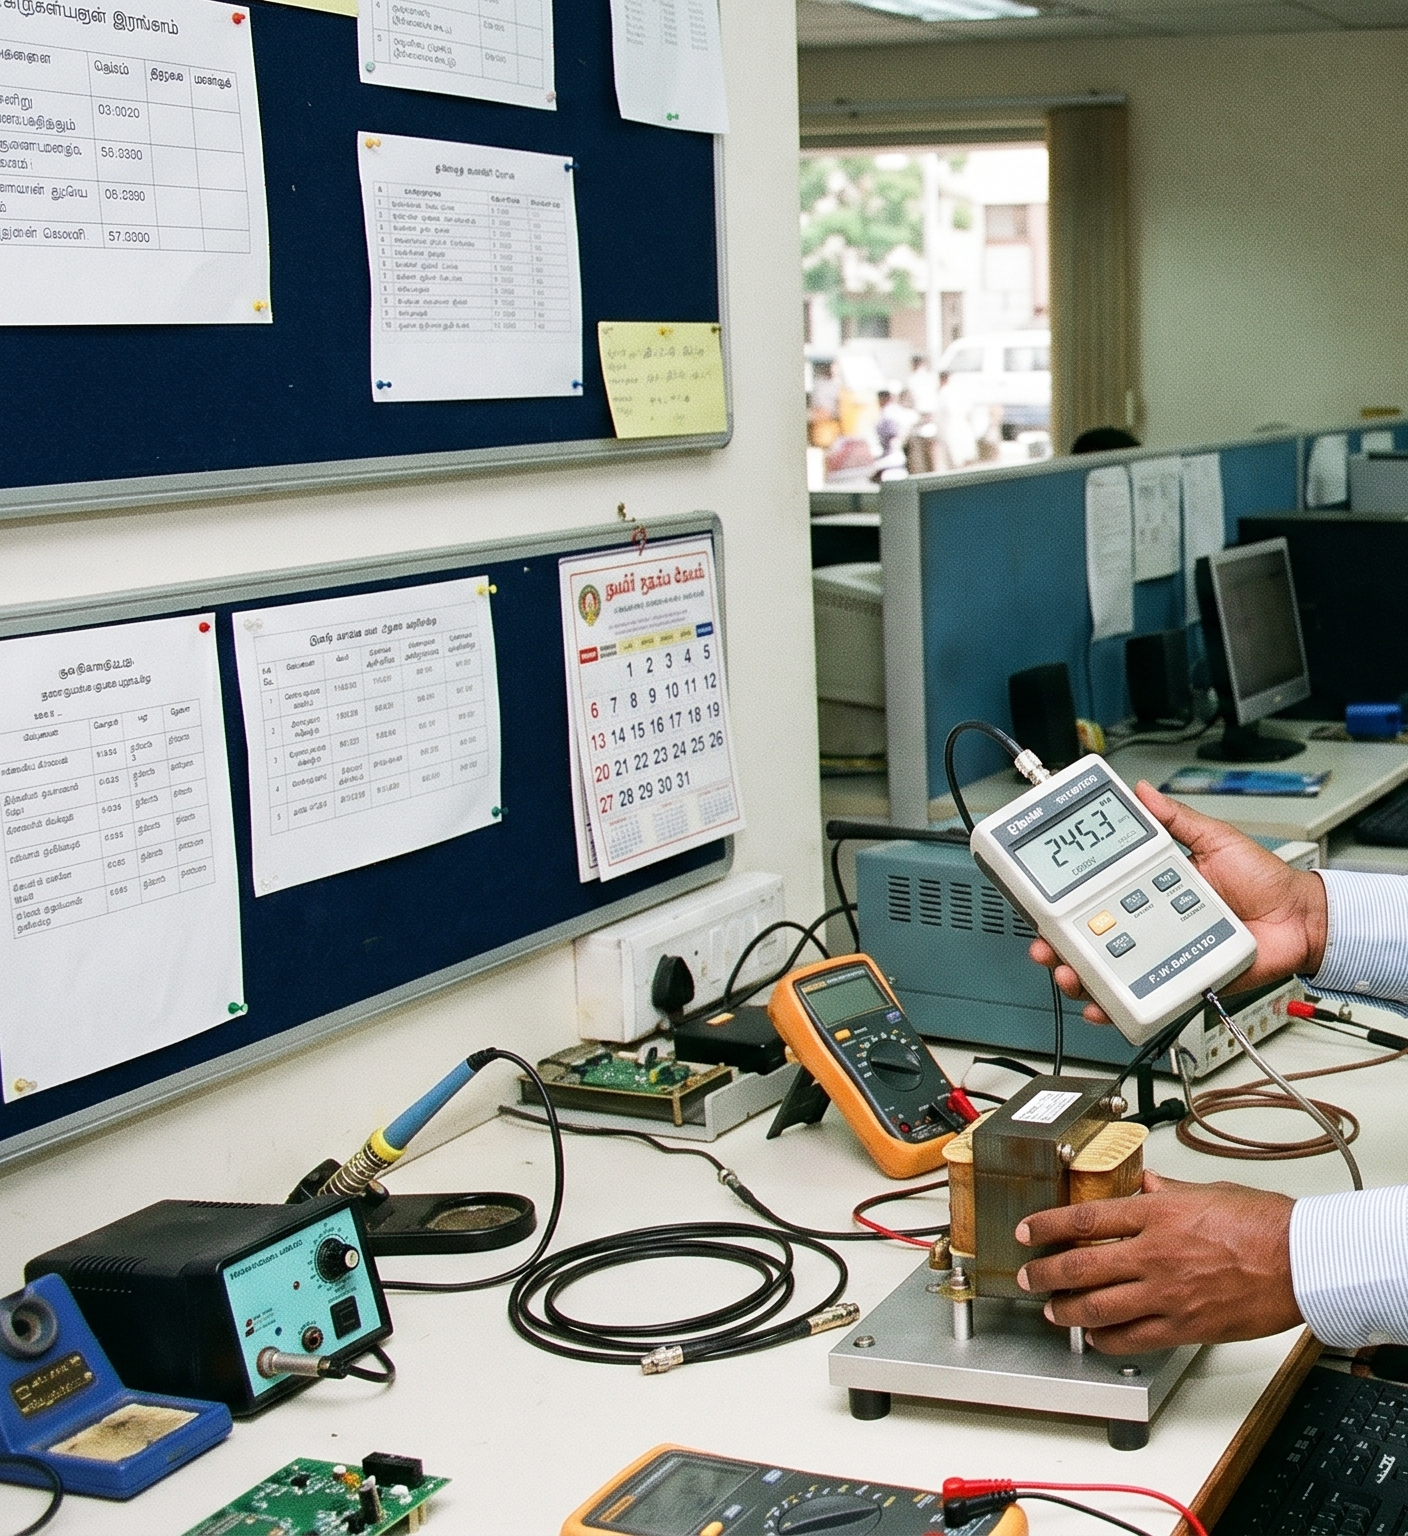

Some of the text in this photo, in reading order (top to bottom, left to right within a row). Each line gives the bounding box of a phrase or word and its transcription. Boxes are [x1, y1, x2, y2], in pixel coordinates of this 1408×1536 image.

[627, 644, 710, 677] 1 2 3 4 5
[591, 673, 716, 718] 6 7 8 9 10 11 12
[592, 702, 719, 751] 13 14 15 16 17 18 19
[595, 731, 723, 782] 20 21 22 23 24 25 26
[600, 772, 689, 813] 27 28 29 30 31
[1044, 809, 1117, 868] 245.3
